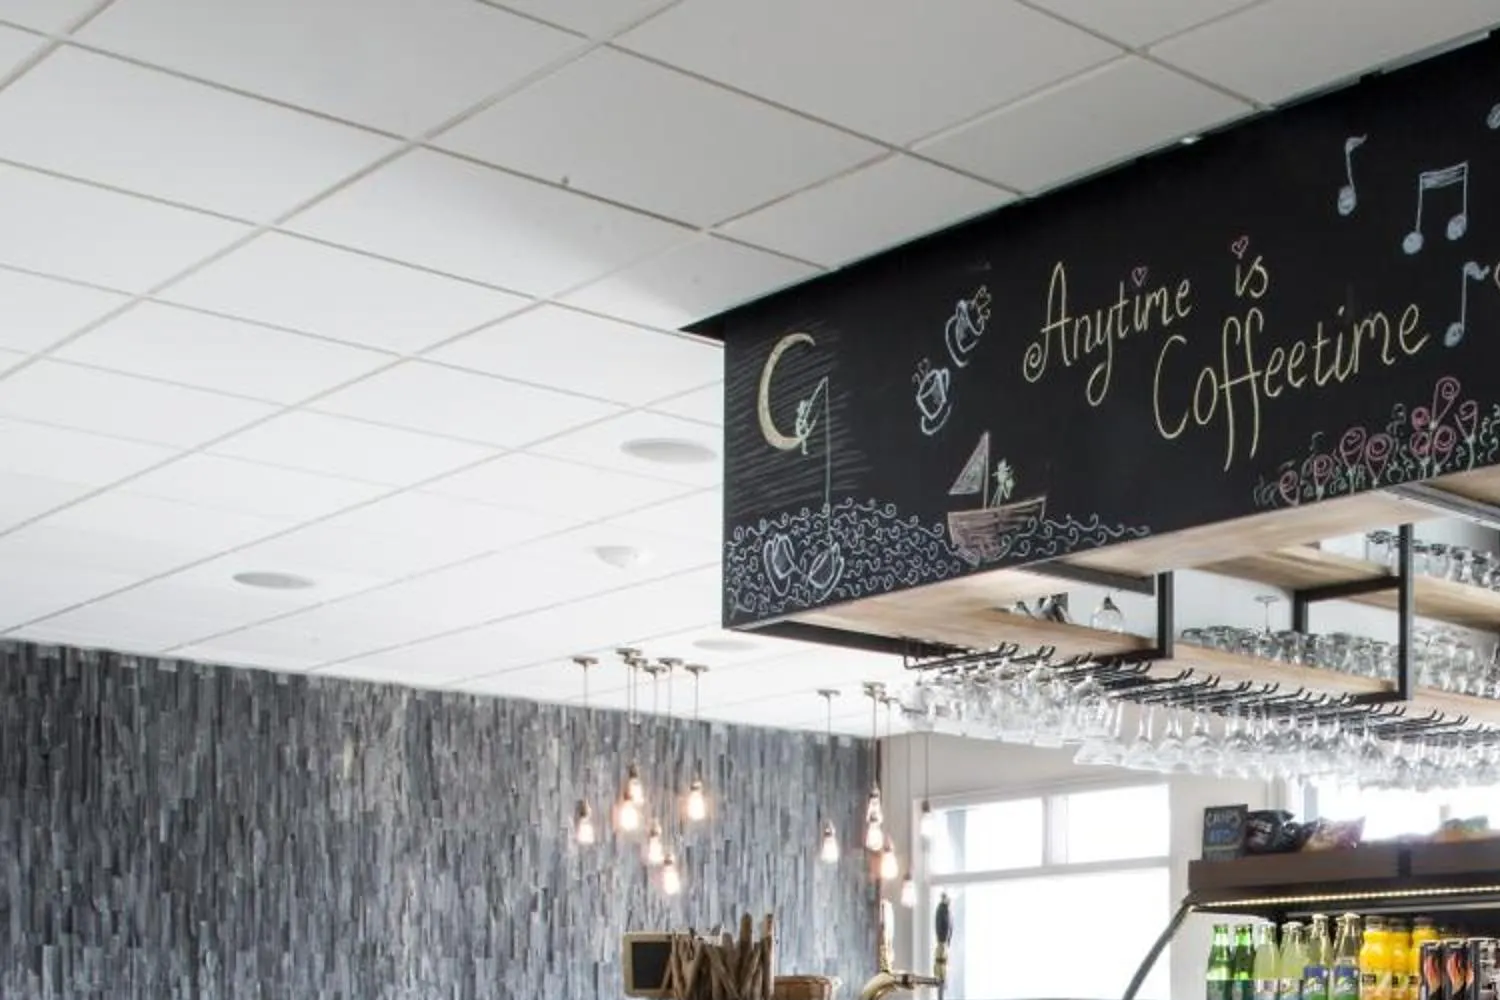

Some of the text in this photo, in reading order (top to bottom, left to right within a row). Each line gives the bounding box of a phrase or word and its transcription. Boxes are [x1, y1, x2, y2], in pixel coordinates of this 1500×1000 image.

[1022, 240, 1270, 406] Anytime is
[1152, 303, 1432, 471] Coffeetime
